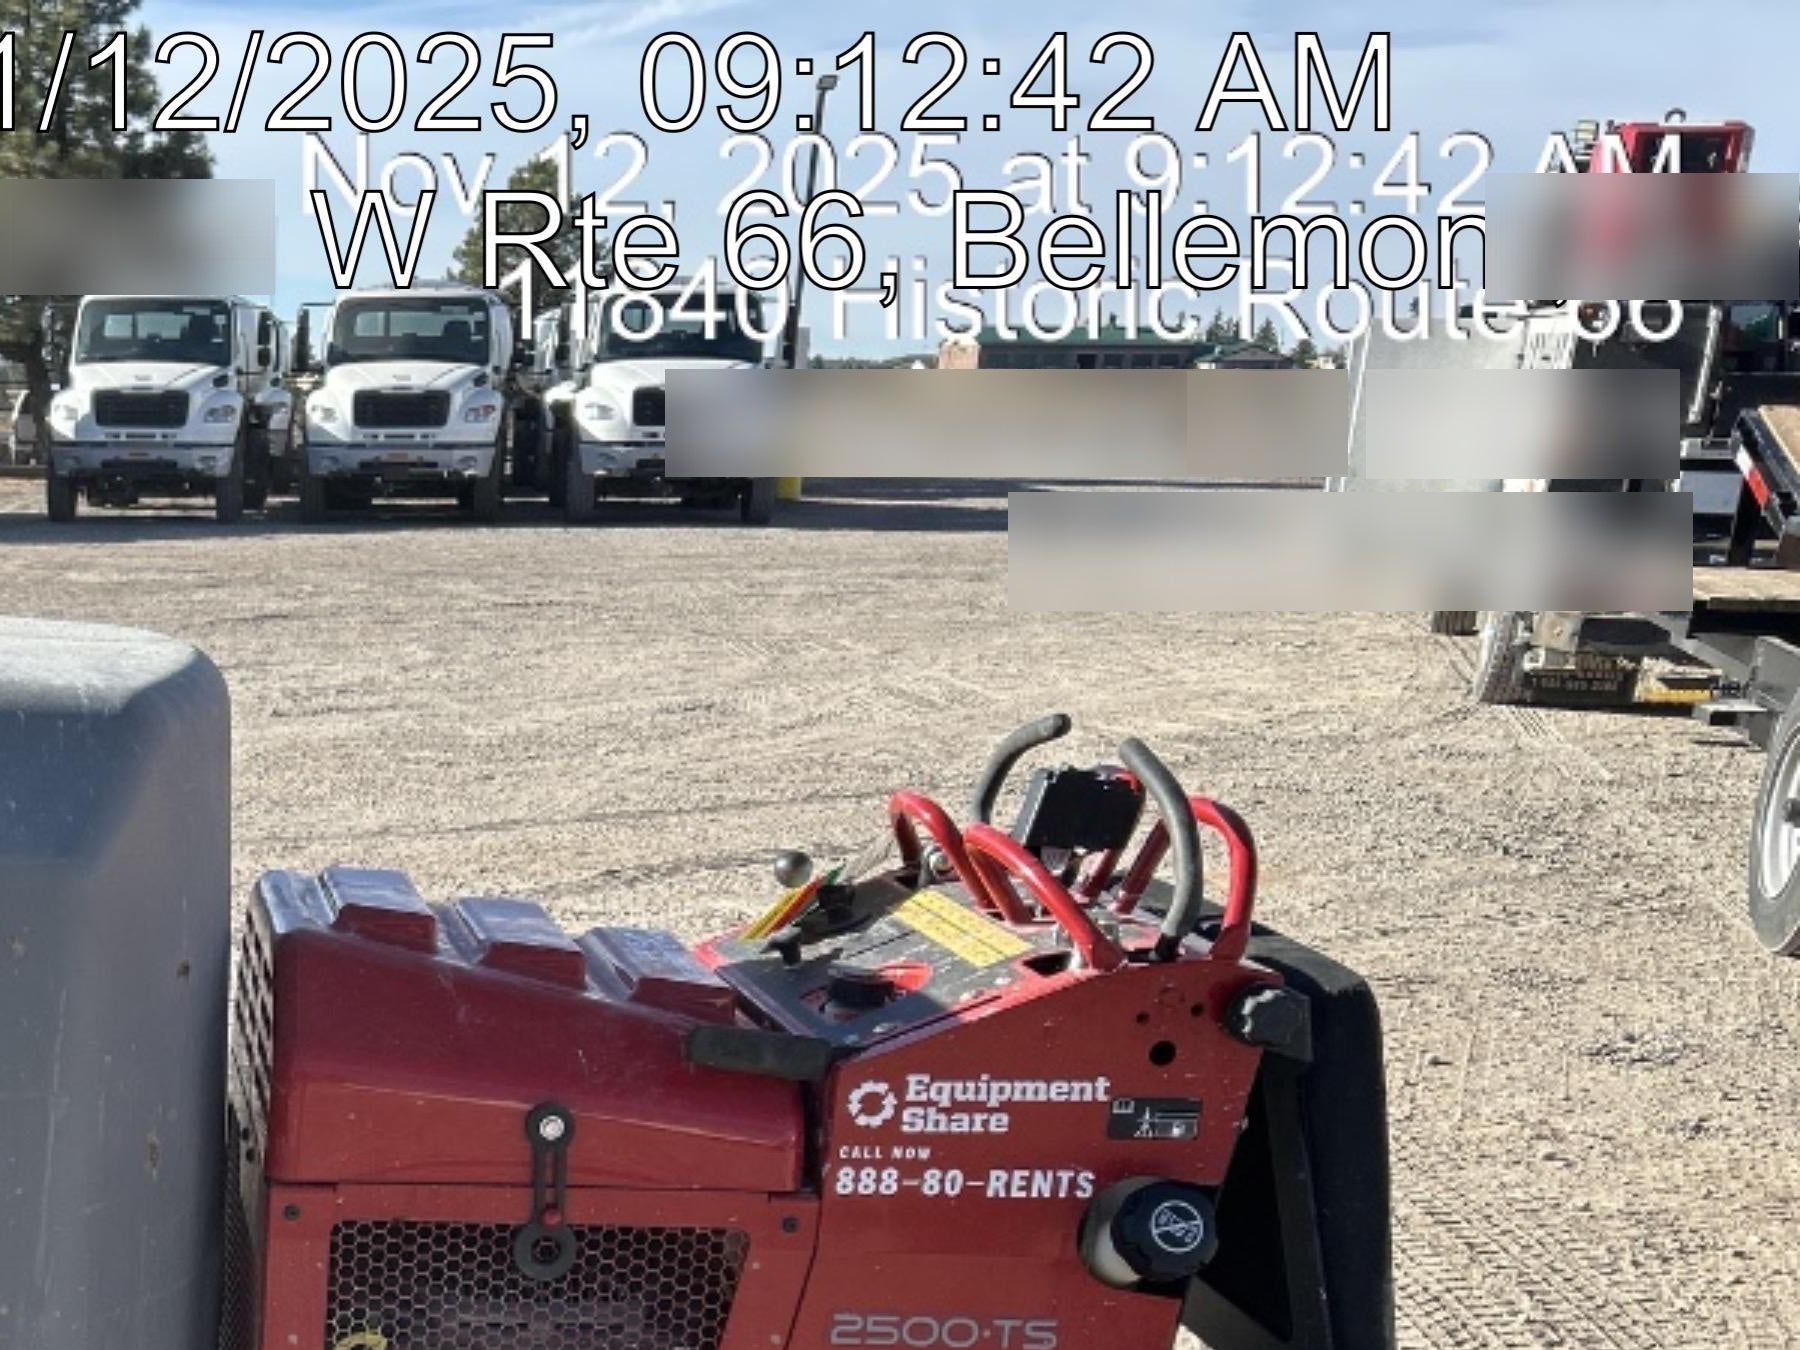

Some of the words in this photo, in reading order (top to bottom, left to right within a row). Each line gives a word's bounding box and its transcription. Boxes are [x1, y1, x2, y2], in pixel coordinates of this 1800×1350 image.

[904, 1073, 1111, 1107] Equipment
[901, 1106, 1010, 1133] Share
[838, 1145, 884, 1160] CALL
[891, 1146, 932, 1161] NOW
[835, 1166, 1097, 1199] 888-80-RENTS
